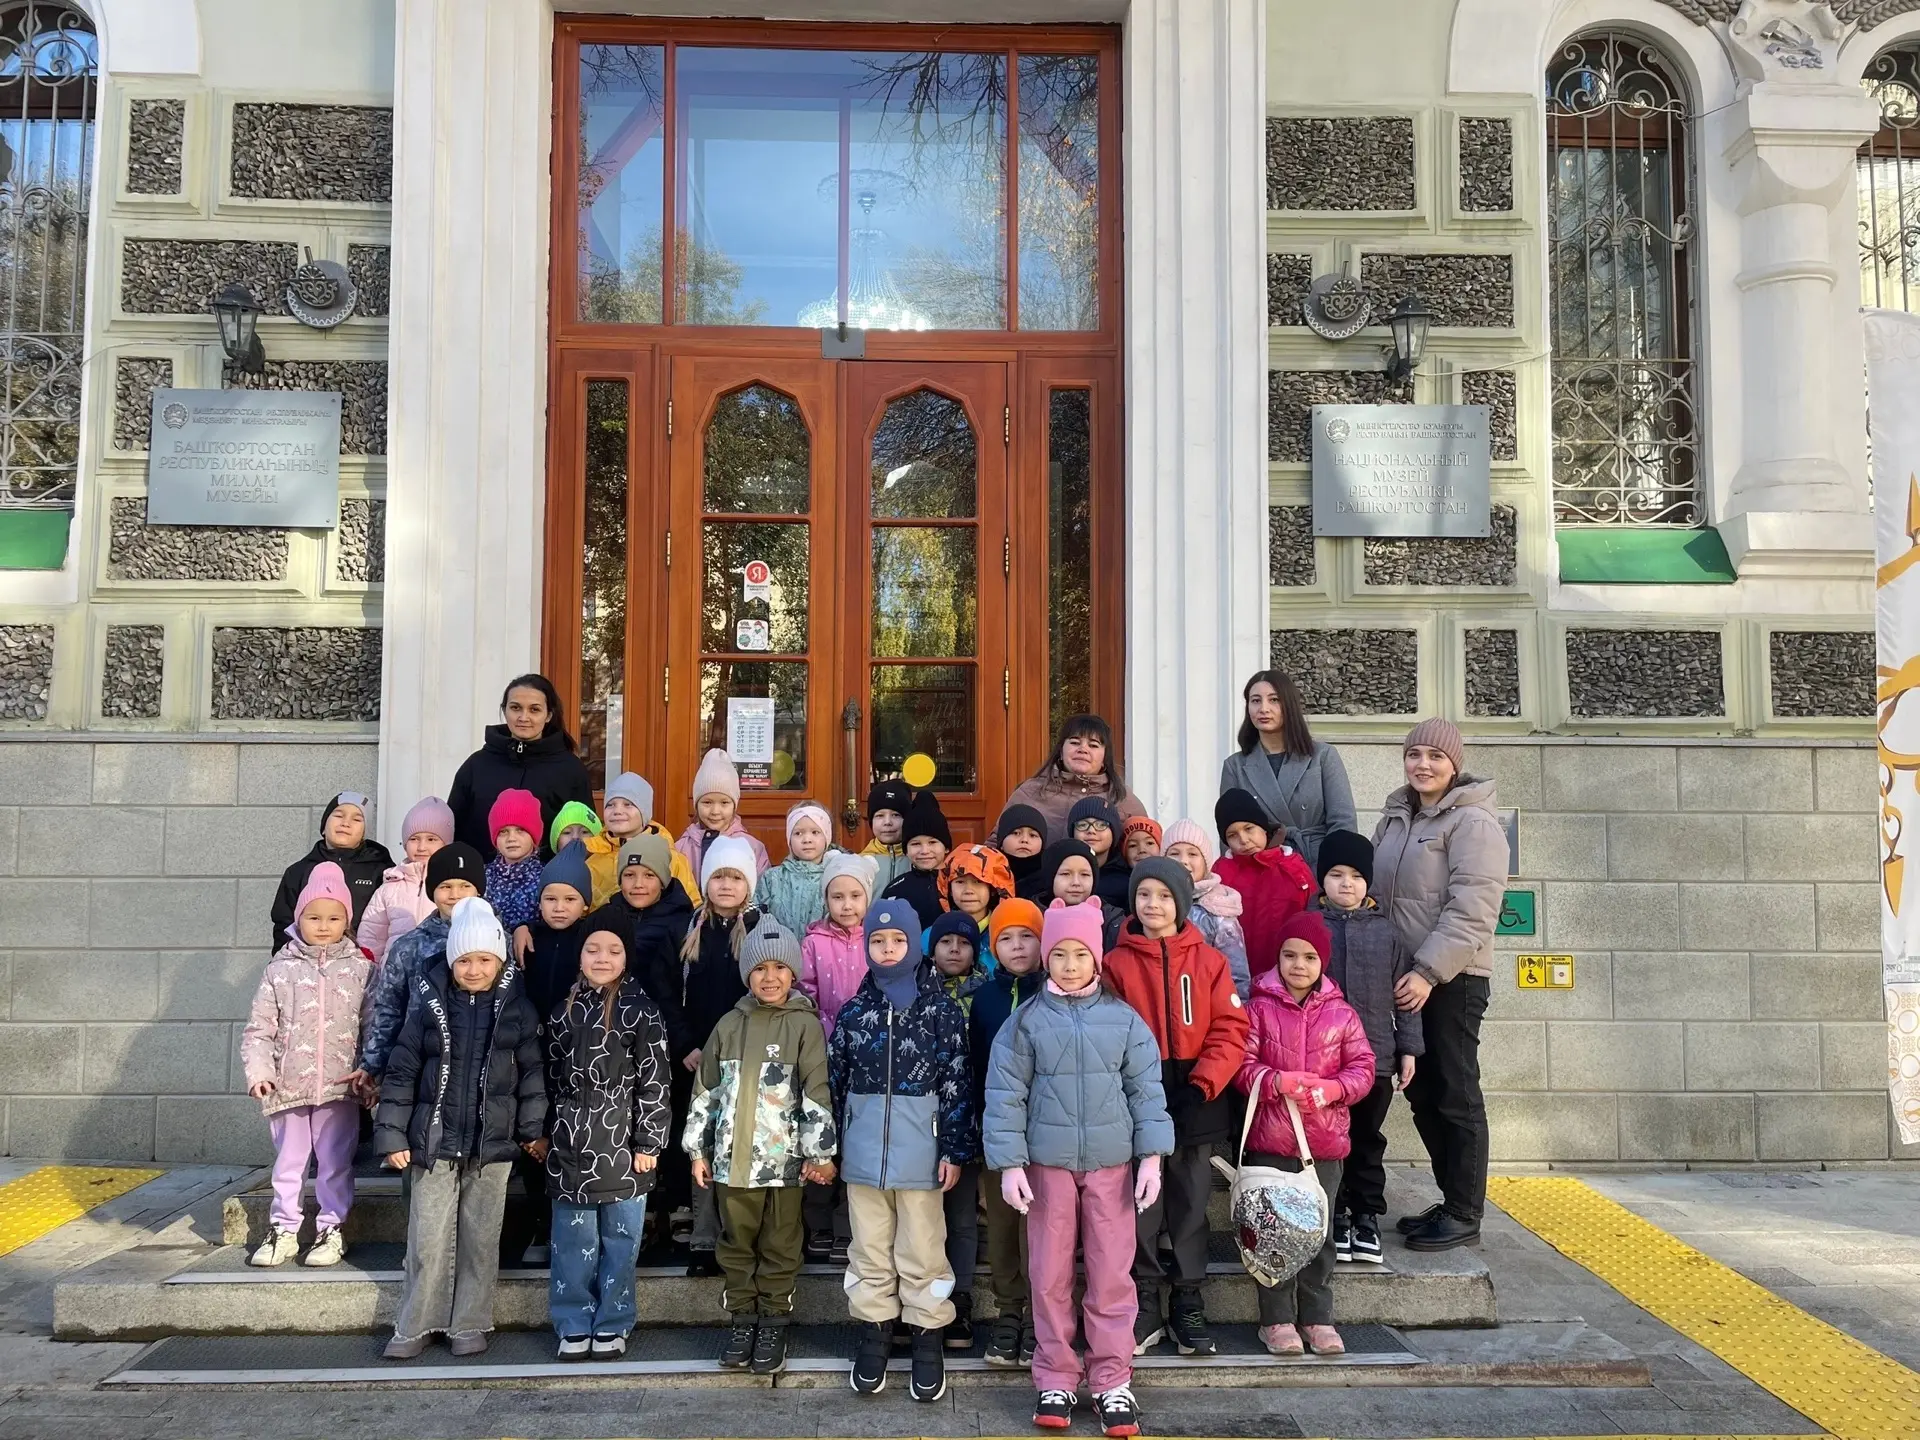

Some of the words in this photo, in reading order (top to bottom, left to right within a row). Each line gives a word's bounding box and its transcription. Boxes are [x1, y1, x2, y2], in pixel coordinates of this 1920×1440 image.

[1356, 422, 1420, 431] МИНИСТЕРСТВО
[1423, 422, 1464, 431] КУЛЬТУРЫ
[1356, 431, 1409, 440] РЕСПУБЛИКИ
[1411, 431, 1477, 440] БАШКОРТОСТАН
[1334, 451, 1469, 468] НАЦИОНАЛЬНЫЙ
[210, 474, 276, 488] МИЛЛИ
[1373, 467, 1430, 483] МУЗЕЙ
[206, 487, 279, 504] МУЗЕЙЫ
[1349, 485, 1455, 499] РЕСПУБЛИКИ
[1335, 499, 1469, 515] БАШКОРТОСТАН
[752, 566, 763, 580] Я
[427, 998, 452, 1053] MONCLER
